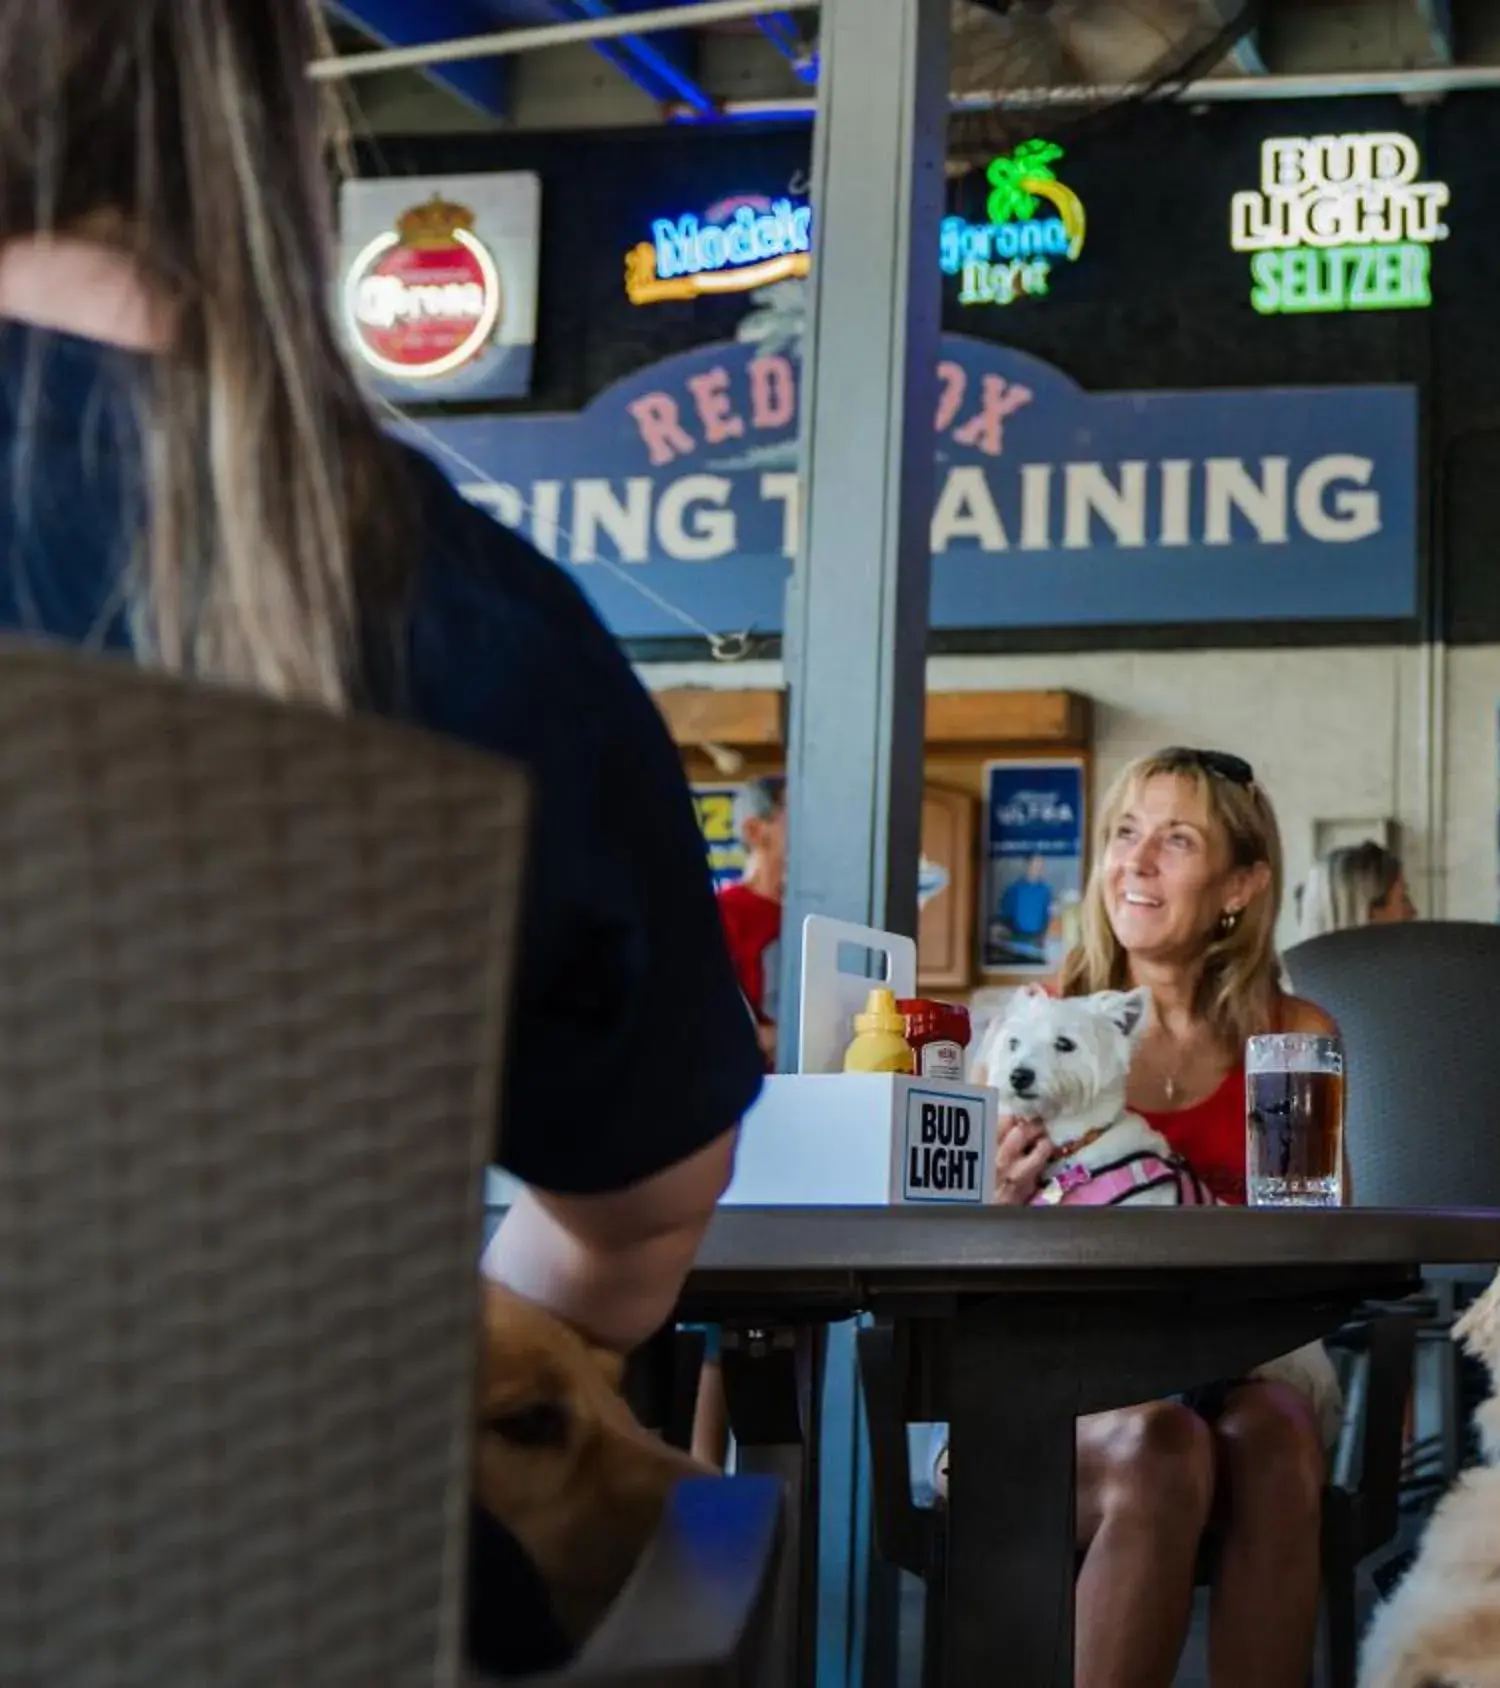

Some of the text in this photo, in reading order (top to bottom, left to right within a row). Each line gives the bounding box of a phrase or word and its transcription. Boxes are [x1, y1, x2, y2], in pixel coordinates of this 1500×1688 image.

[1262, 133, 1419, 196] BUD
[1232, 183, 1449, 250] LIGHT
[1251, 246, 1432, 313] SELTZER
[625, 355, 1033, 466] RED OX
[760, 453, 1382, 556] TAINING
[920, 1103, 971, 1147] BUD
[909, 1147, 979, 1191] LIGHT
